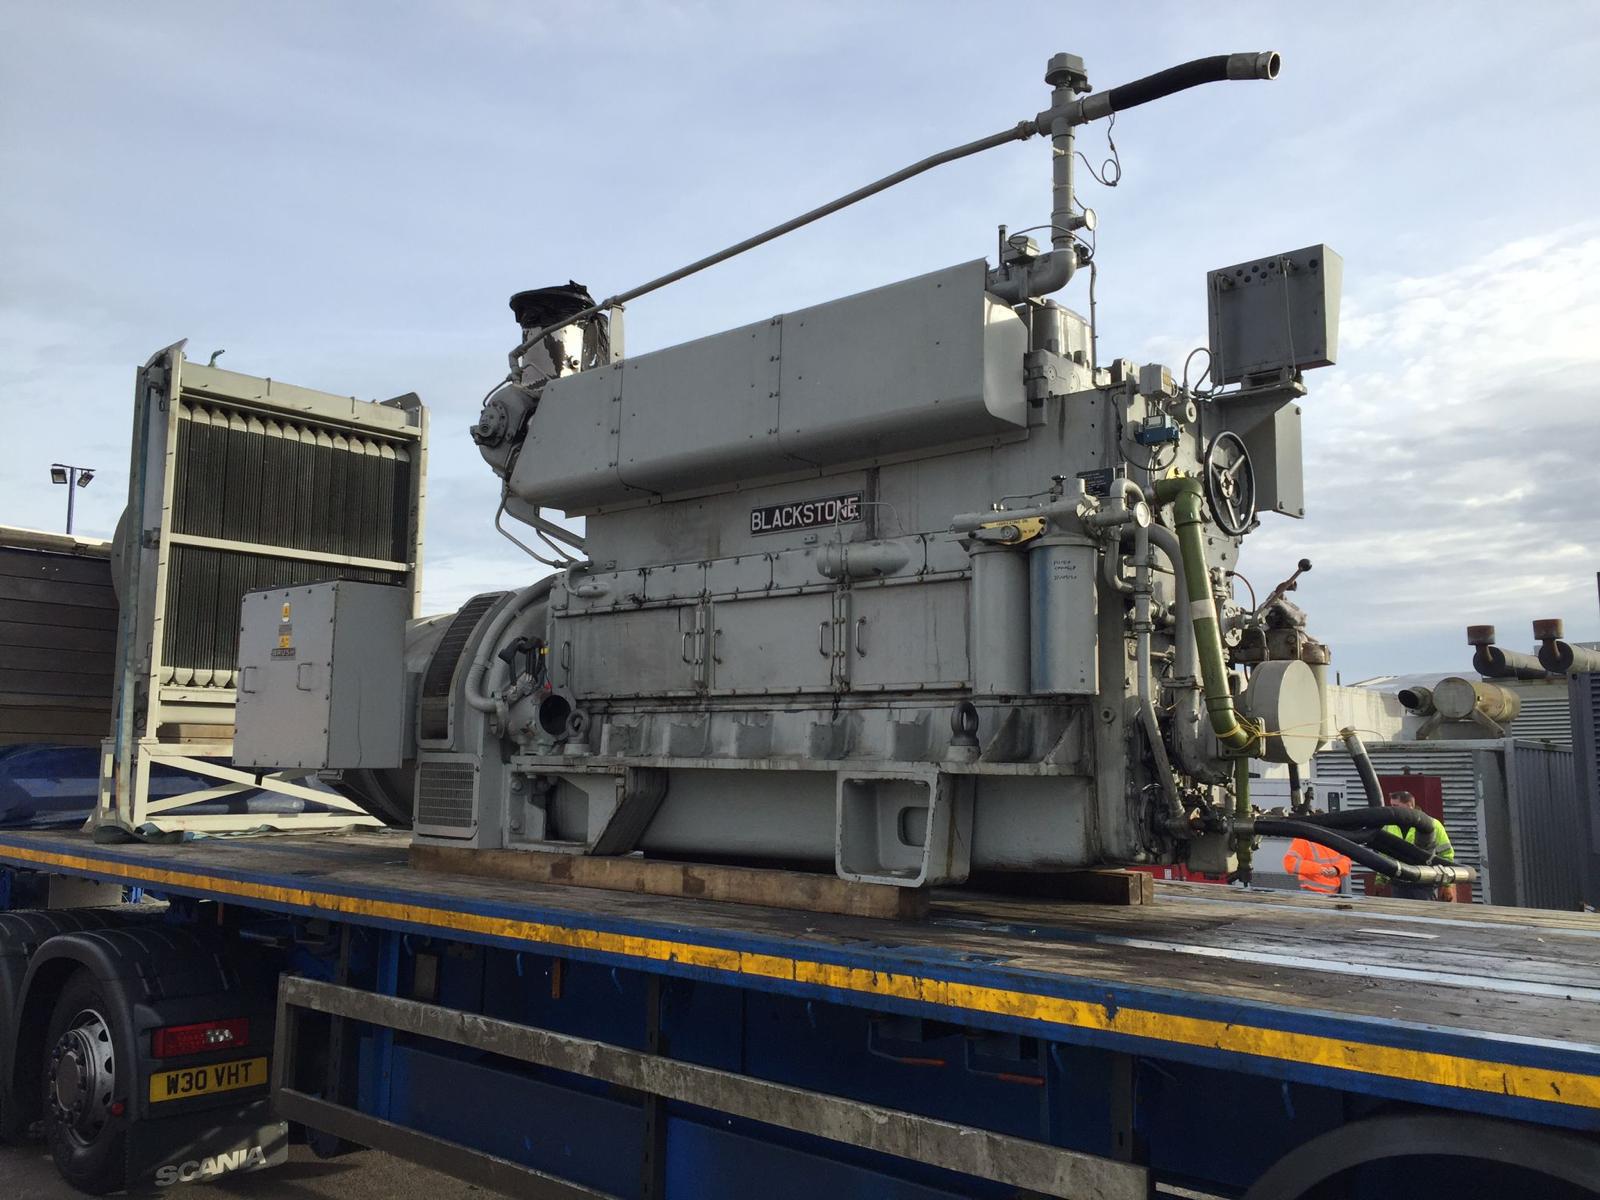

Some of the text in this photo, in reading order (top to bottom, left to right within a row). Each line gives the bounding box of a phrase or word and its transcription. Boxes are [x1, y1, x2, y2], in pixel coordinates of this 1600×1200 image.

[751, 497, 859, 531] BLACKSTONE
[167, 1062, 253, 1096] W30 VHT
[154, 1145, 267, 1187] SCANIA
